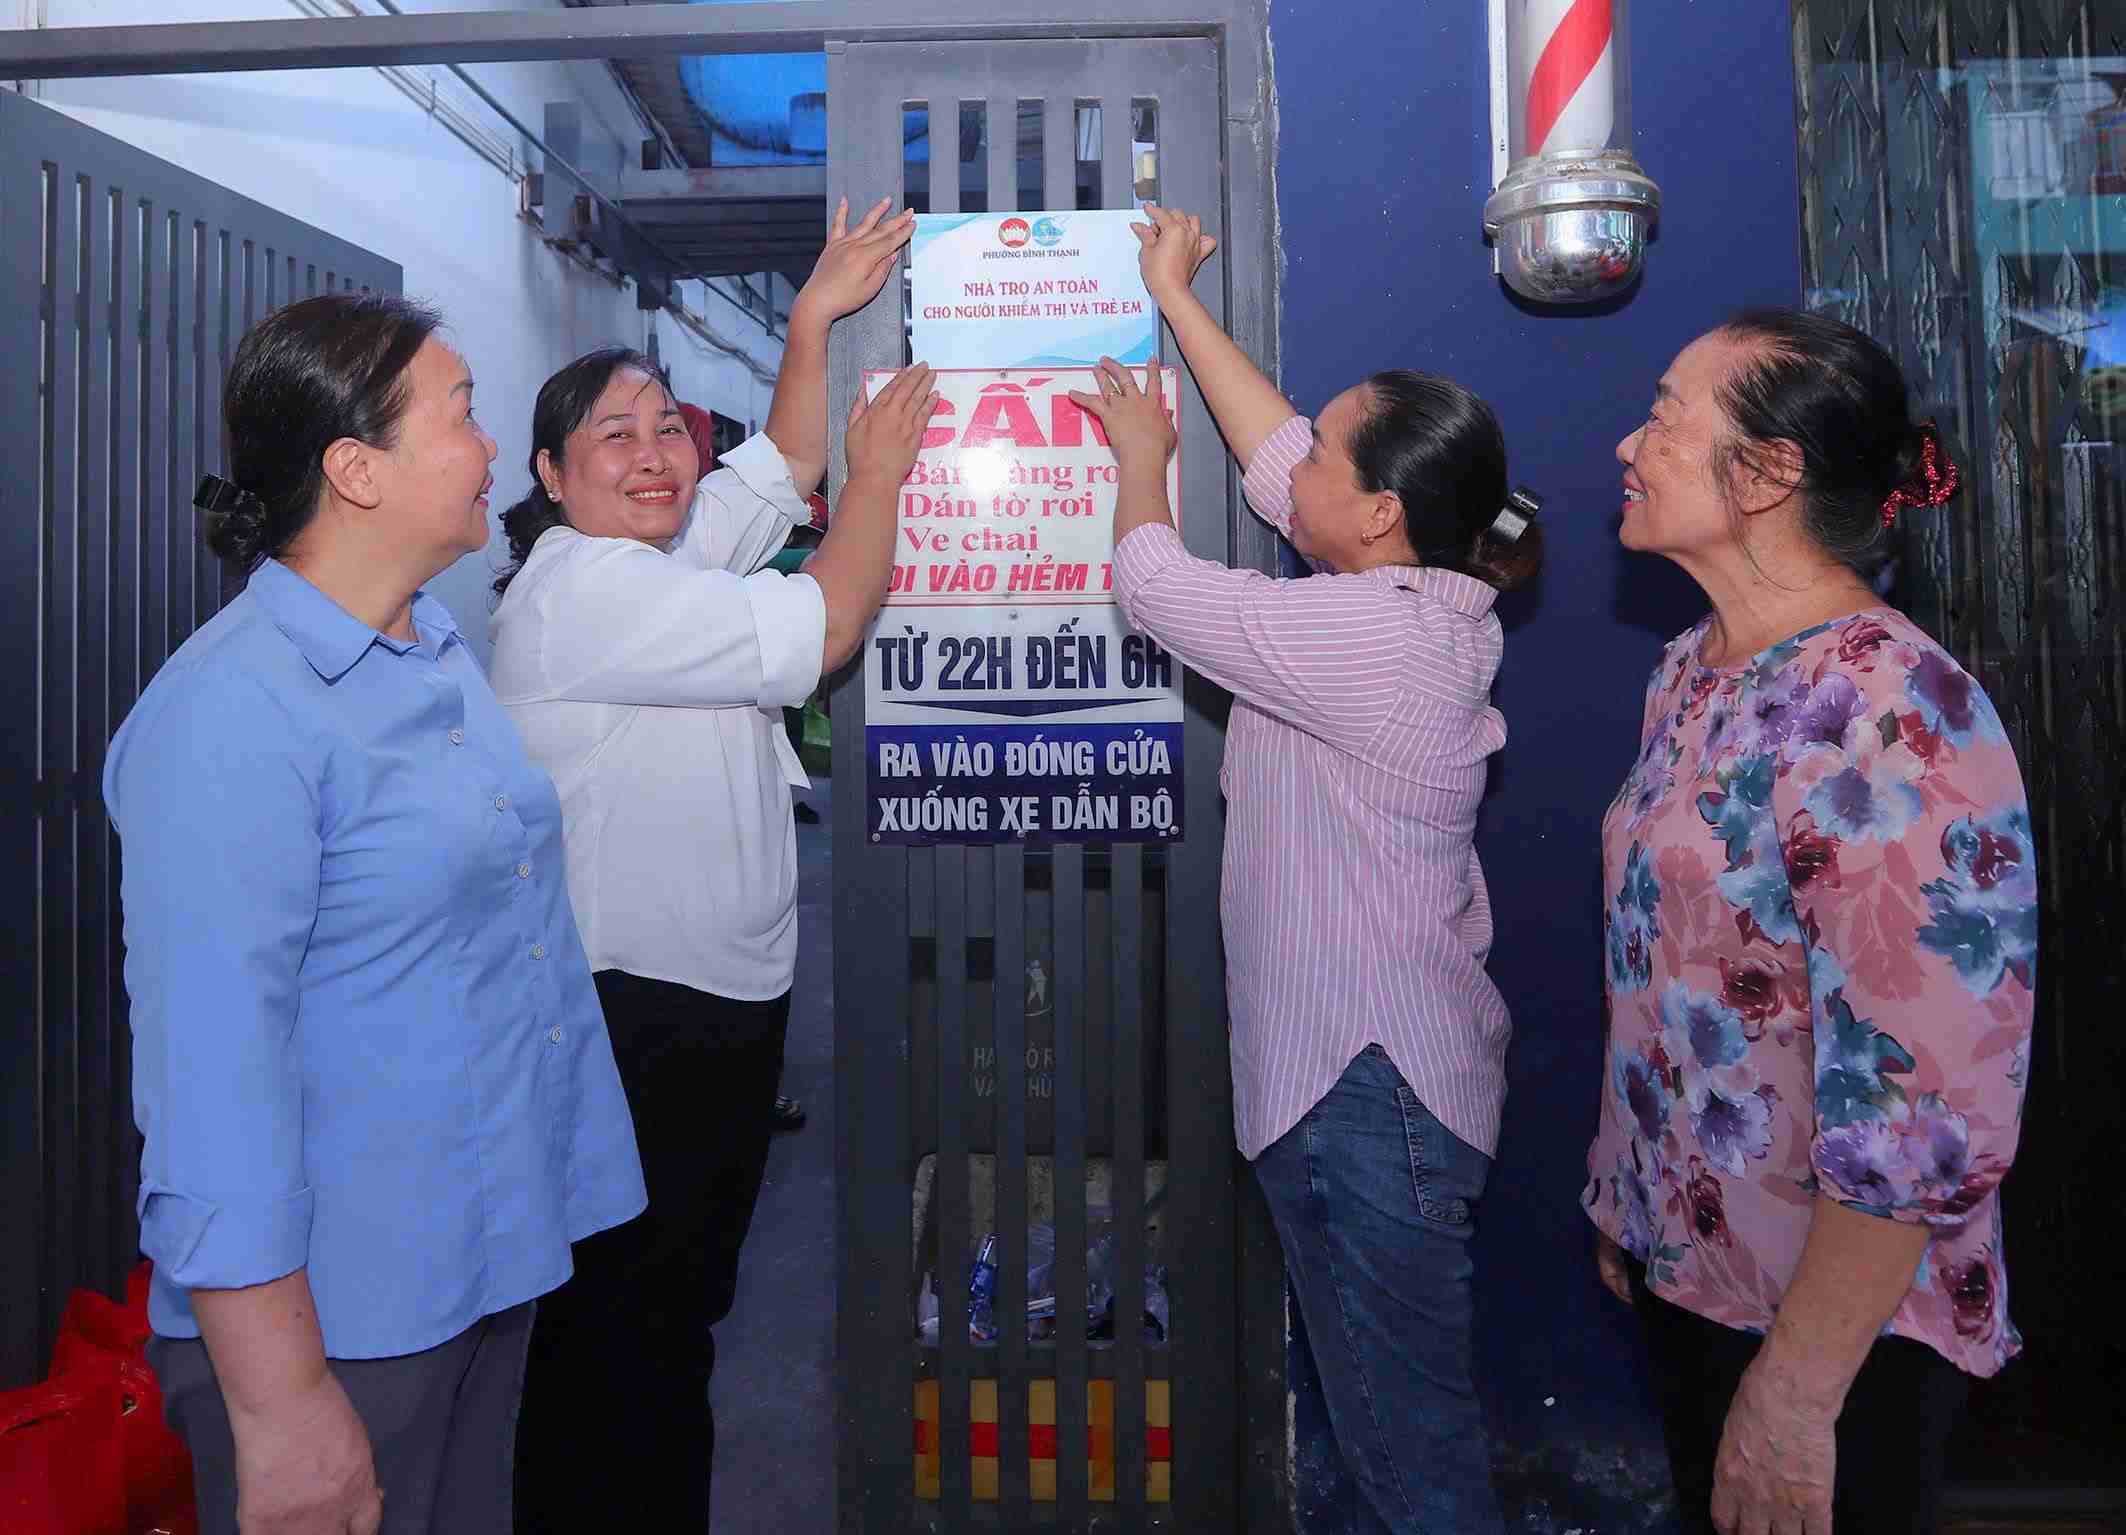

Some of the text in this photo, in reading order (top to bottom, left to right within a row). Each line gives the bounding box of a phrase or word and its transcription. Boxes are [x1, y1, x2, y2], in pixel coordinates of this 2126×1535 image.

[1033, 280, 1054, 295] AN
[1057, 274, 1098, 294] TOÀN
[923, 304, 951, 319] CHO
[1121, 301, 1142, 314] EM
[1086, 464, 1120, 485] ro
[904, 492, 977, 518] Dán
[1042, 491, 1095, 518] rơi
[903, 526, 1039, 552] Ve chai
[928, 559, 997, 592] VÀO
[1008, 555, 1089, 592] HẺM
[876, 617, 1172, 691] TỪ 22H ĐẾN 6H
[879, 729, 1172, 777] RA VÀO ĐÓNG CỬA
[878, 783, 1173, 837] XUỐNG XE DẪN BỘ
